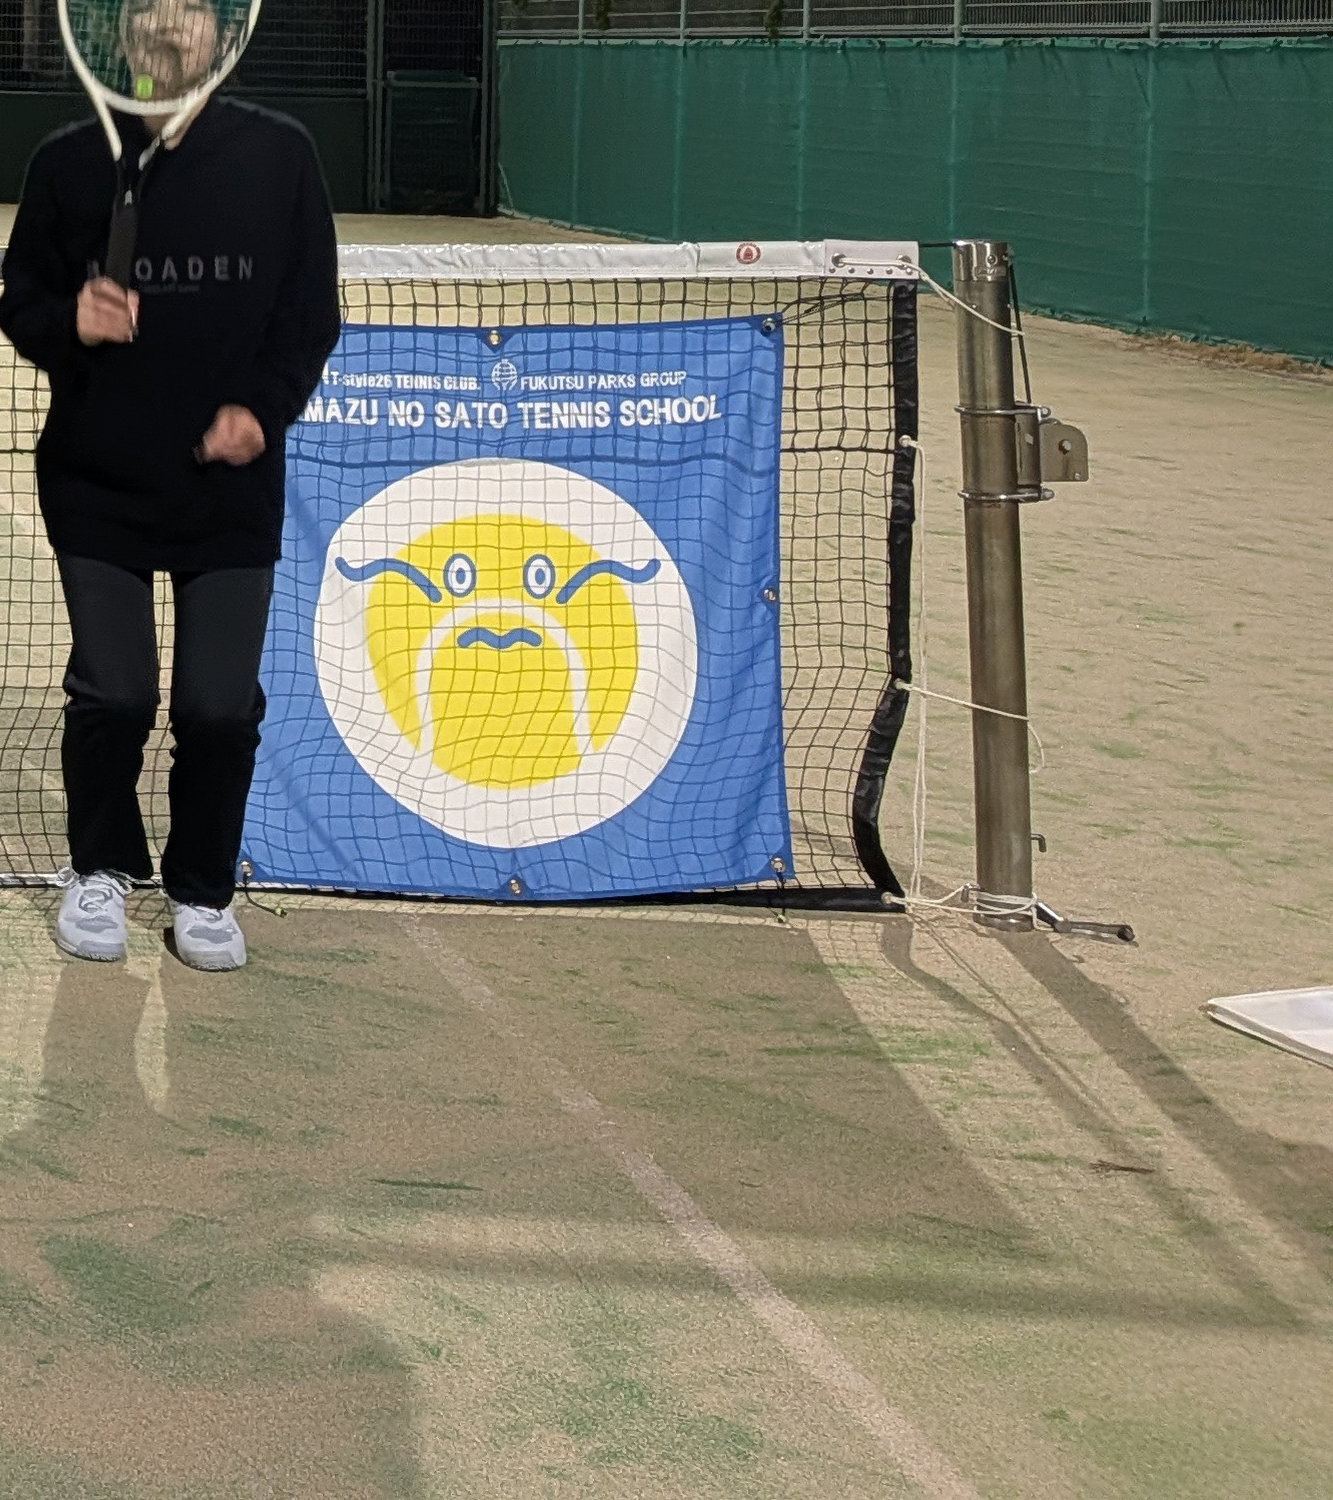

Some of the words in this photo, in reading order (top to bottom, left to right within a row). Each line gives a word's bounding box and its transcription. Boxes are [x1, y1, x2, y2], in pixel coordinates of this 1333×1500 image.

[86, 255, 253, 282] OADEN
[394, 374, 441, 390] TENNIS
[520, 374, 584, 391] FUKUTSU
[588, 372, 636, 390] PARKS
[640, 370, 687, 388] GROUP
[298, 396, 379, 426] MAZU
[387, 399, 425, 428] NO
[434, 400, 509, 429] SATO
[517, 399, 611, 430] TENNIS
[619, 394, 722, 427] SCHOOL
